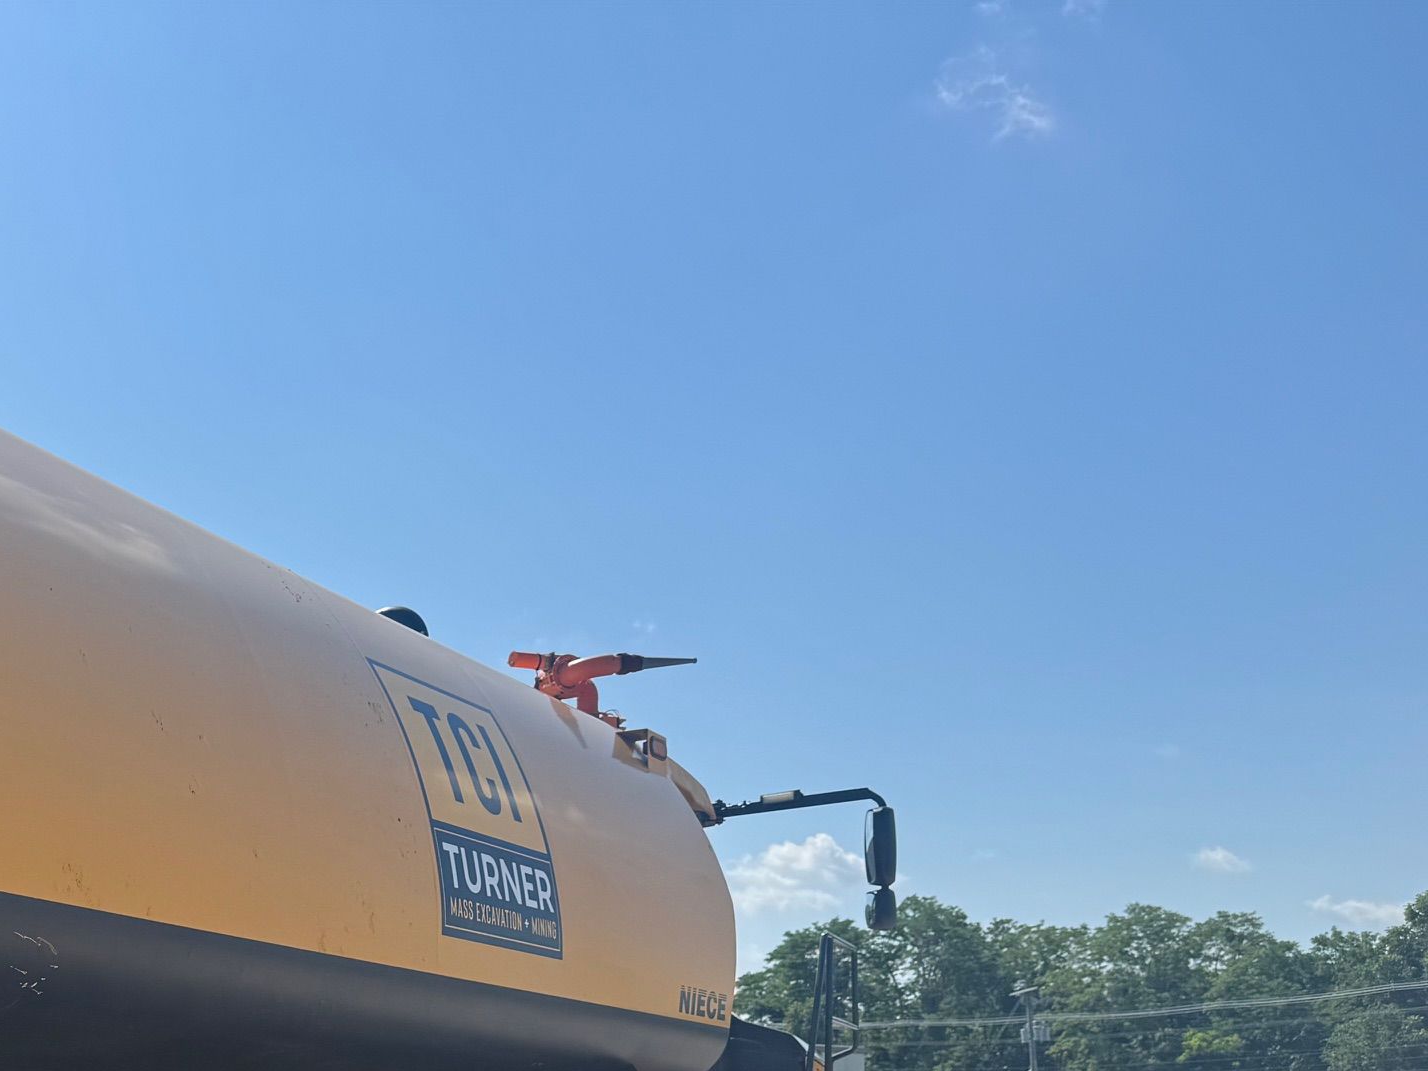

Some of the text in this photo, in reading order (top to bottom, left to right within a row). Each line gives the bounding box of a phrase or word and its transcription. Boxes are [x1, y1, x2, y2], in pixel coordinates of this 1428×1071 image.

[407, 696, 522, 823] TCI
[442, 843, 554, 913] TURNER
[450, 897, 473, 920] MASS
[476, 902, 522, 931] EXCAVATION
[532, 917, 557, 939] MINING
[679, 985, 727, 1021] NIECE
